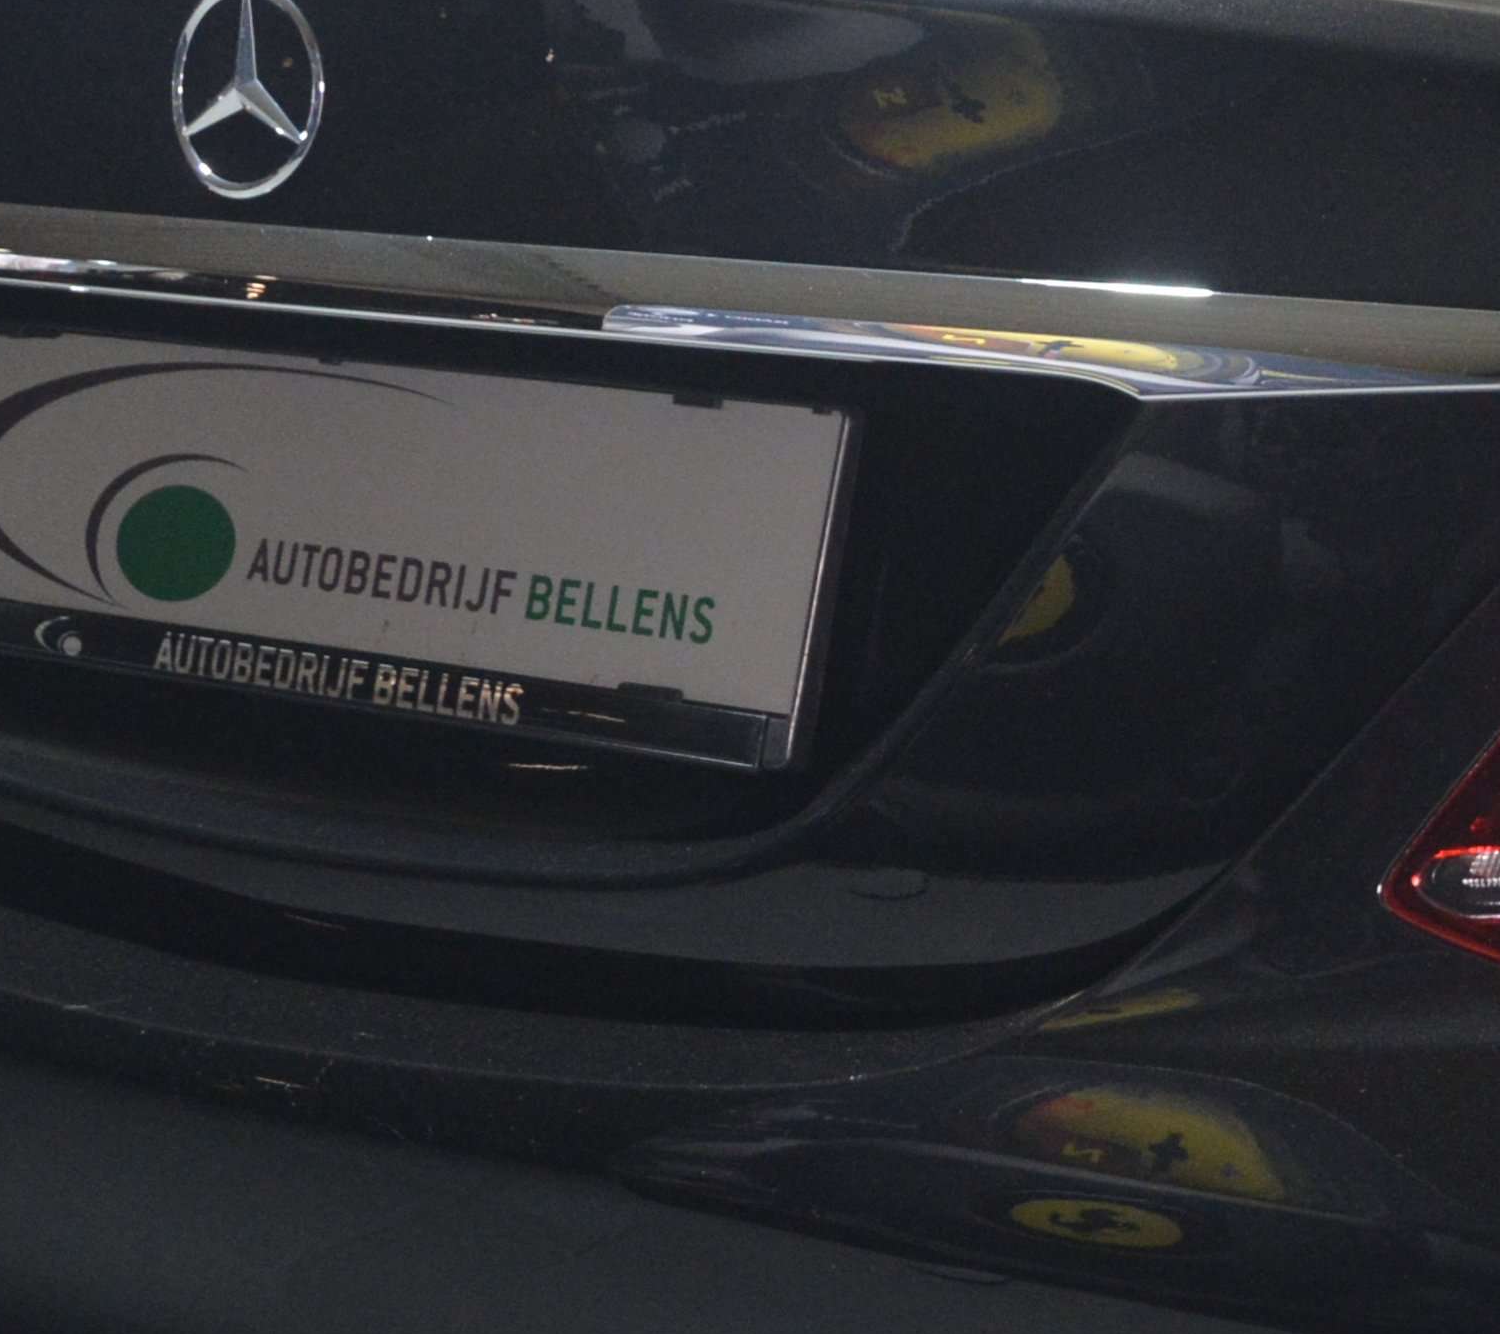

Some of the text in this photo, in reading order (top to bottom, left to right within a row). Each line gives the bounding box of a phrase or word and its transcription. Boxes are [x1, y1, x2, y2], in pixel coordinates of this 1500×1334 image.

[247, 538, 716, 645] AUTOBEDRIJF BELLENS
[155, 631, 524, 726] AUTOBEDRIJF BELLENS
